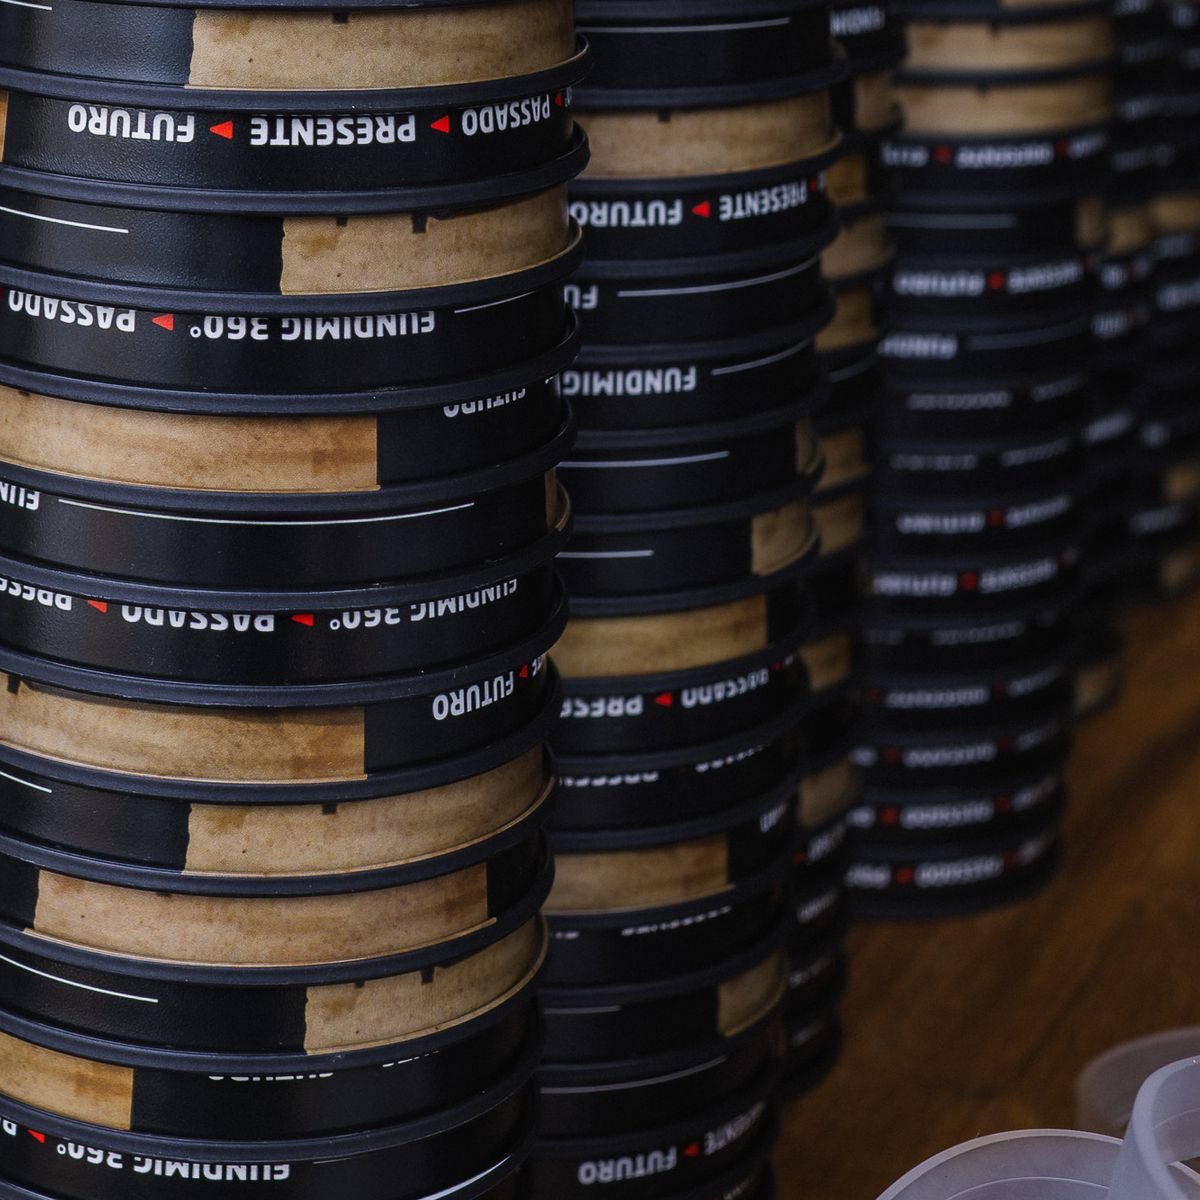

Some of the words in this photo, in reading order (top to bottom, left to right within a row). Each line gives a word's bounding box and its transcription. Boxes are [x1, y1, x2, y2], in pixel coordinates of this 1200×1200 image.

[68, 105, 194, 142] FUTURO
[251, 116, 415, 146] PRESENTE
[462, 94, 550, 136] PASSADO
[568, 199, 682, 227] FUTURO
[720, 181, 808, 221] PRESENTE
[9, 290, 135, 333] PASSADO
[190, 316, 268, 340] 360°
[282, 311, 434, 340] FUNDIMIG
[562, 366, 696, 395] FUNDIMIG
[433, 672, 513, 720] FUTURO
[577, 1148, 677, 1185] FUTURO
